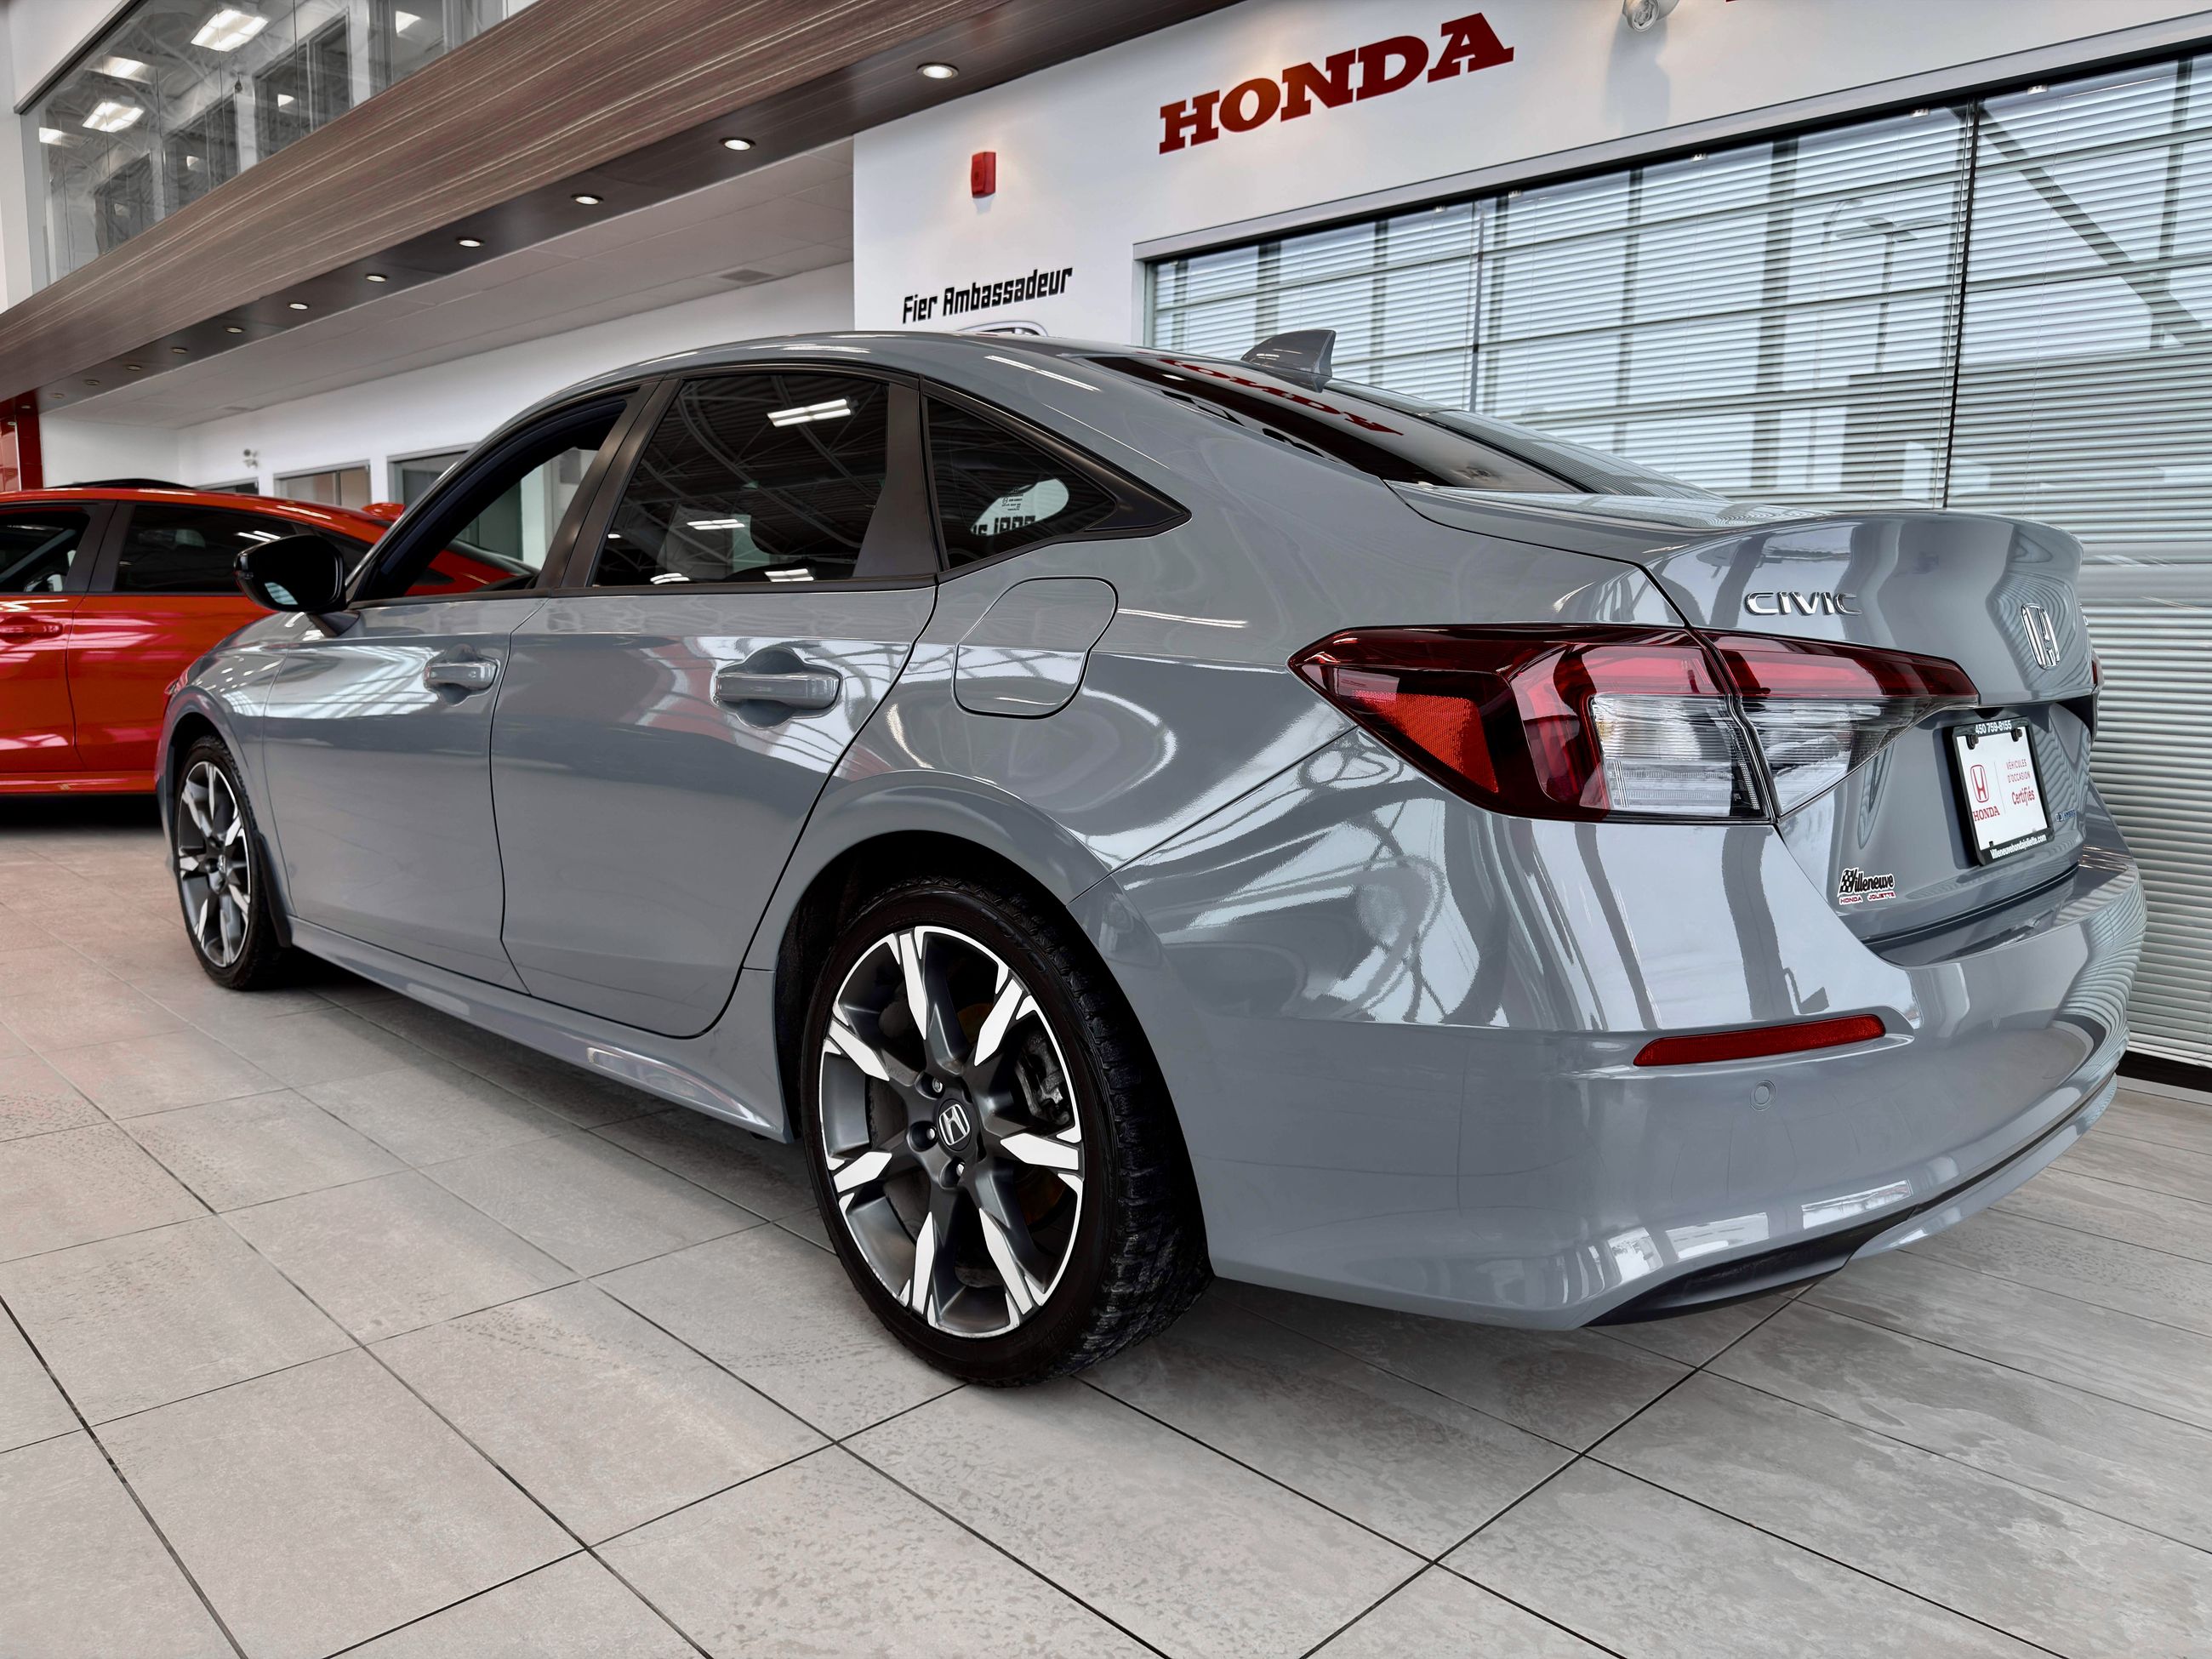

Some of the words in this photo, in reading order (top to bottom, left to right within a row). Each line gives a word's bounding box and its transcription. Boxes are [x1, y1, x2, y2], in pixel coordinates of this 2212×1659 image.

[1159, 12, 1514, 155] HONDA
[903, 294, 938, 324] Fier
[943, 267, 1073, 316] Ambassadeur
[1745, 591, 1862, 616] CIVIC
[1975, 723, 1987, 734] 450
[1987, 720, 2012, 733] 759-8155
[2011, 786, 2035, 807] Certifiés
[1972, 806, 2000, 822] HONDA
[1868, 892, 1895, 900] JOLIETTE
